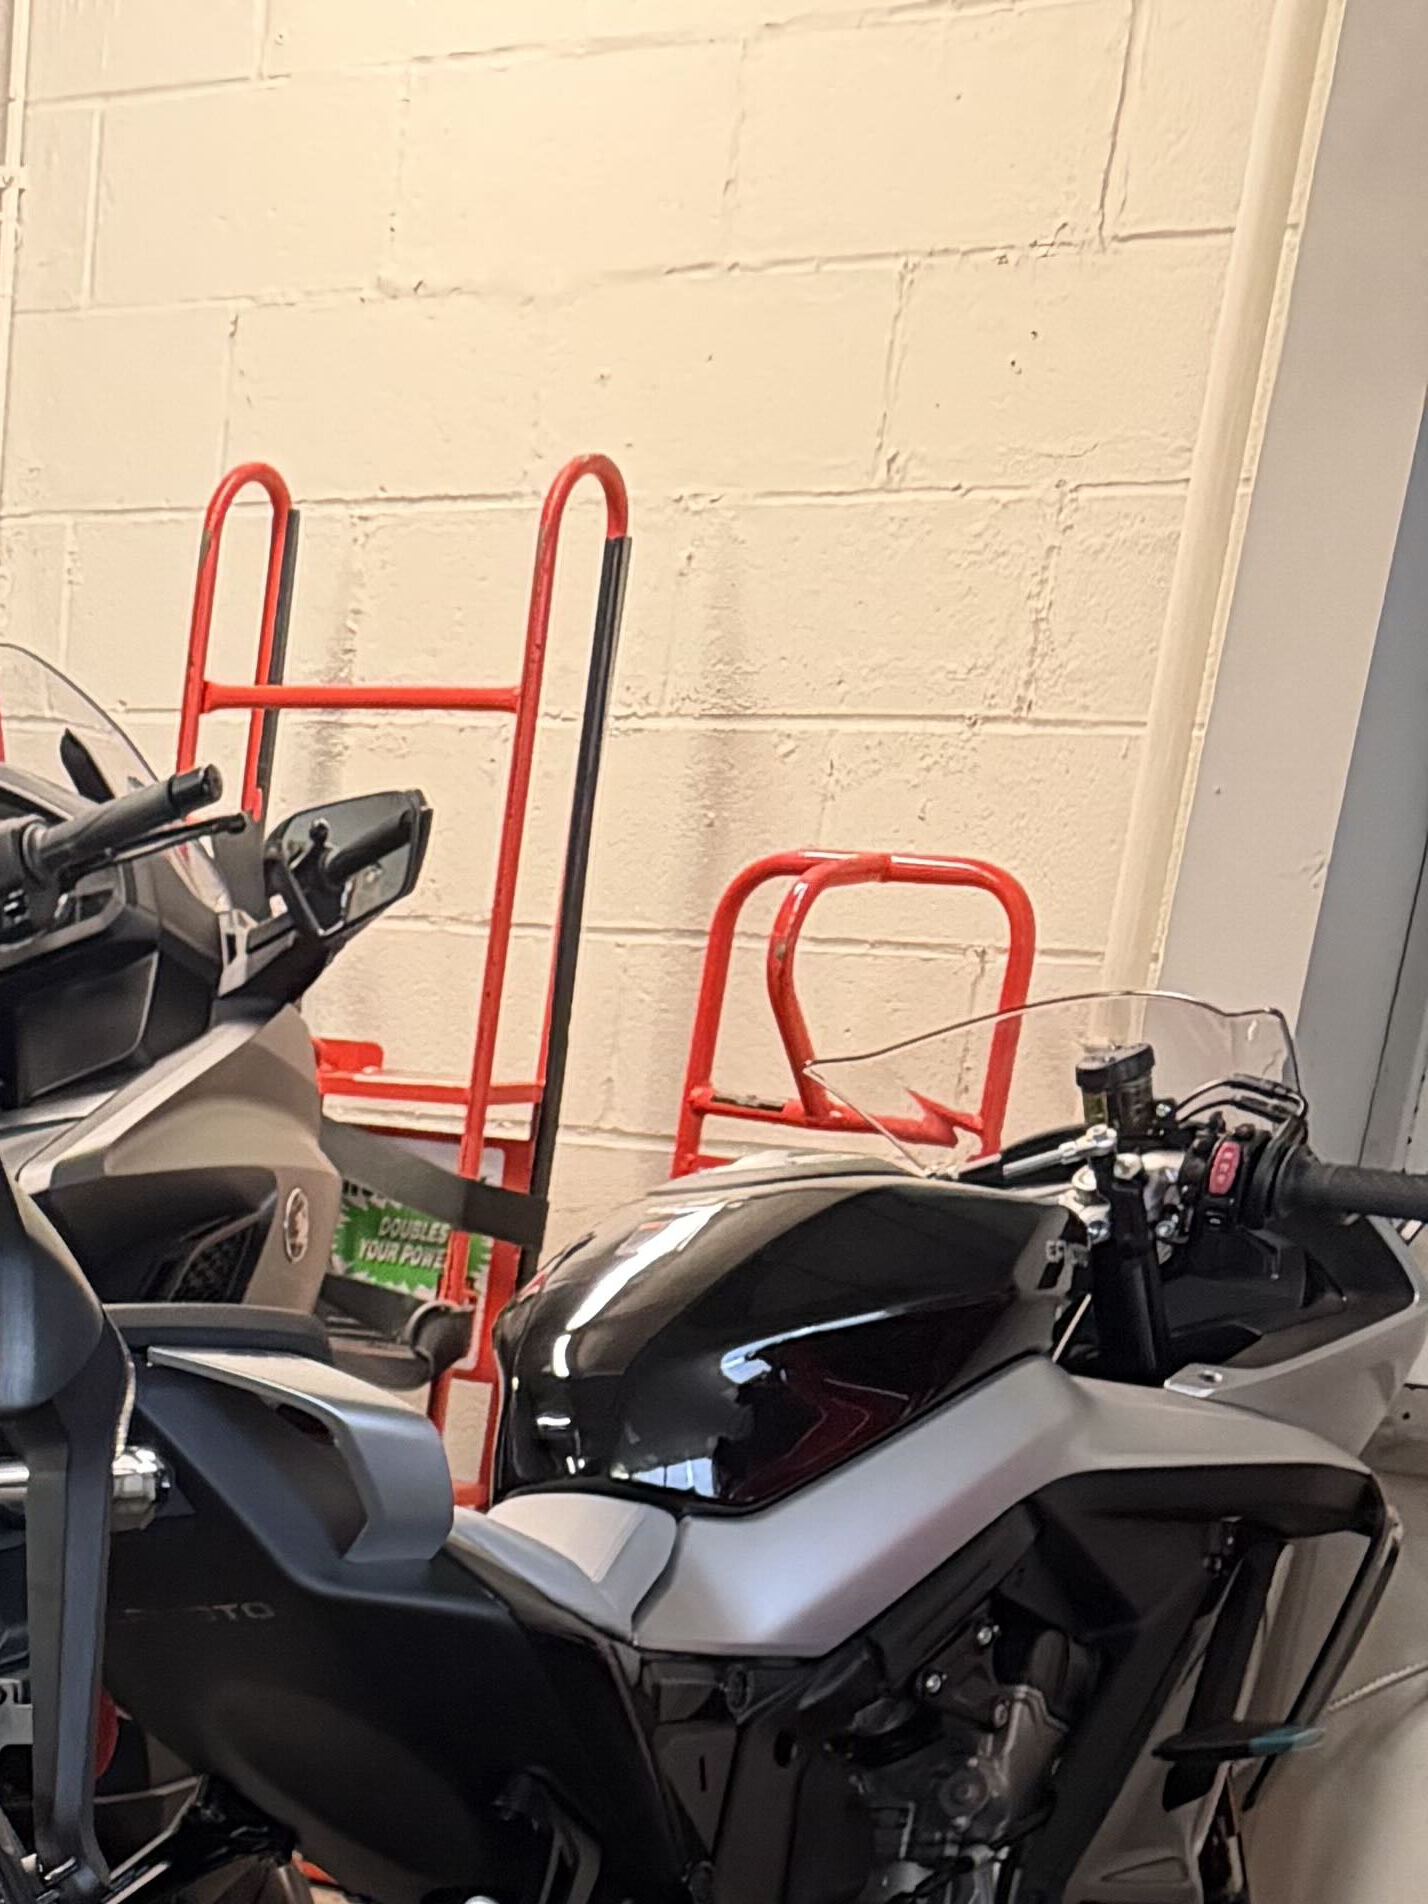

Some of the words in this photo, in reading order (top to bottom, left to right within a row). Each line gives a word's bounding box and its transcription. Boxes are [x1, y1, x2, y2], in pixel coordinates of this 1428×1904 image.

[378, 1215, 451, 1244] DOUBLES
[358, 1238, 400, 1264] YOUR
[399, 1243, 448, 1269] POWE
